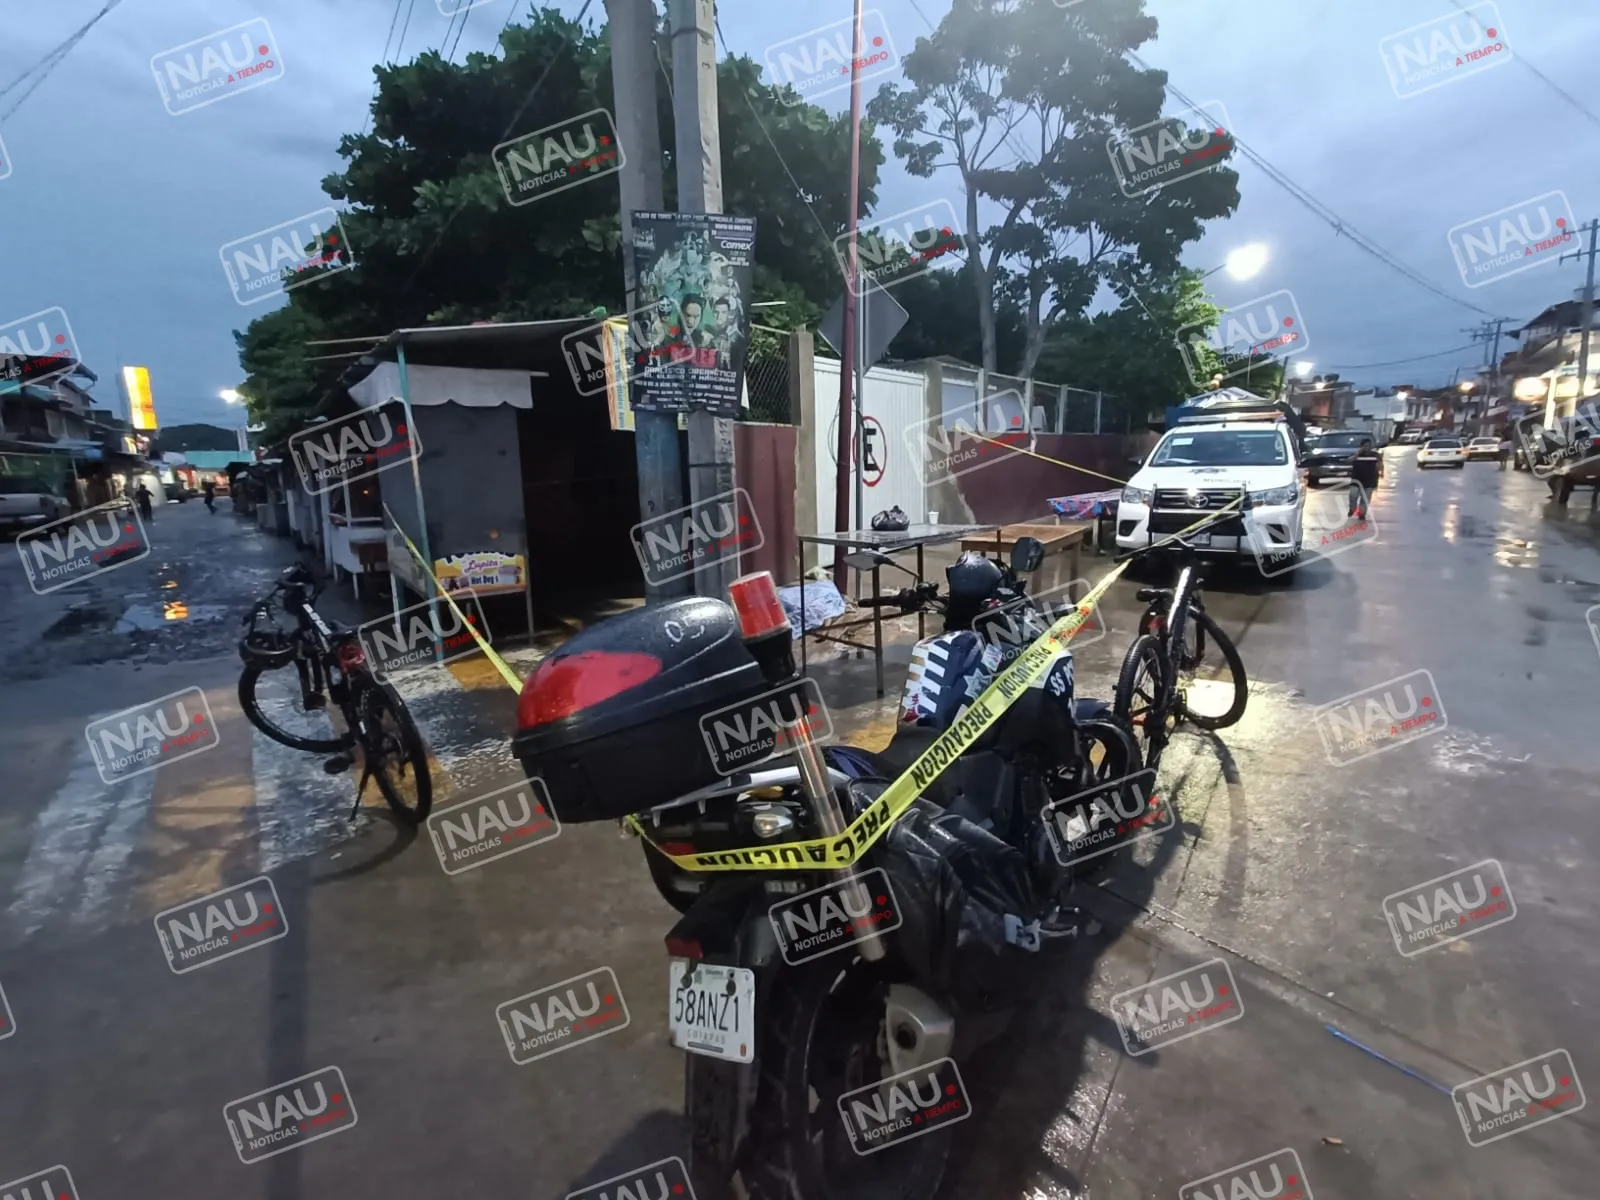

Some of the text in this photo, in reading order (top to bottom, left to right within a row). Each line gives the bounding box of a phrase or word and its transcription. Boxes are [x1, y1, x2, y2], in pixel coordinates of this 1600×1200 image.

[720, 240, 754, 251] Comex
[863, 428, 878, 471] E
[997, 647, 1052, 699] PRECAUCION
[911, 702, 994, 790] PRECAUCION
[675, 987, 738, 1033] 58ANZ1
